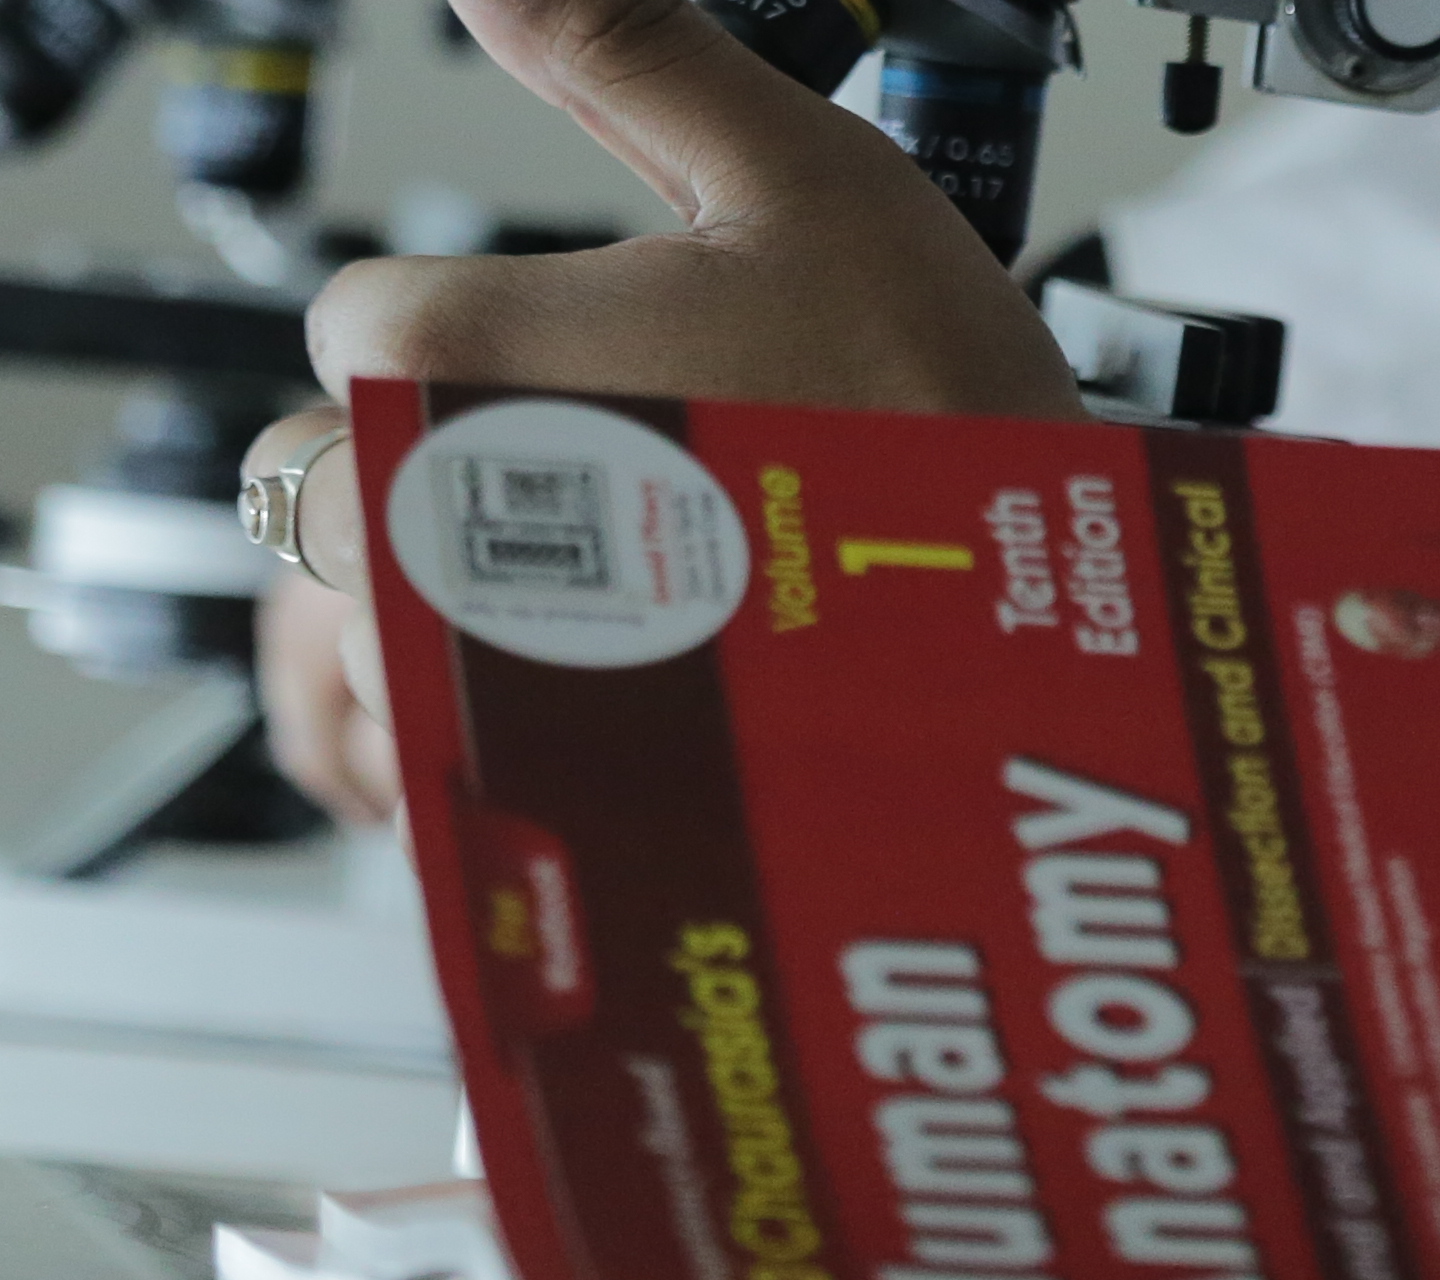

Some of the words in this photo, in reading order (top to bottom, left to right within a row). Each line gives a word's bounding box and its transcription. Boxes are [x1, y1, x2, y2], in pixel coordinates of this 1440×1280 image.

[760, 464, 818, 634] Volume
[837, 538, 974, 578] 1
[984, 488, 1058, 633] Tenth
[1063, 474, 1141, 658] Edition
[1172, 480, 1248, 651] Clinical
[1204, 657, 1265, 745] and
[1227, 754, 1310, 960] Dissection
[1001, 755, 1264, 1280] natomy
[839, 938, 1062, 1280] uman
